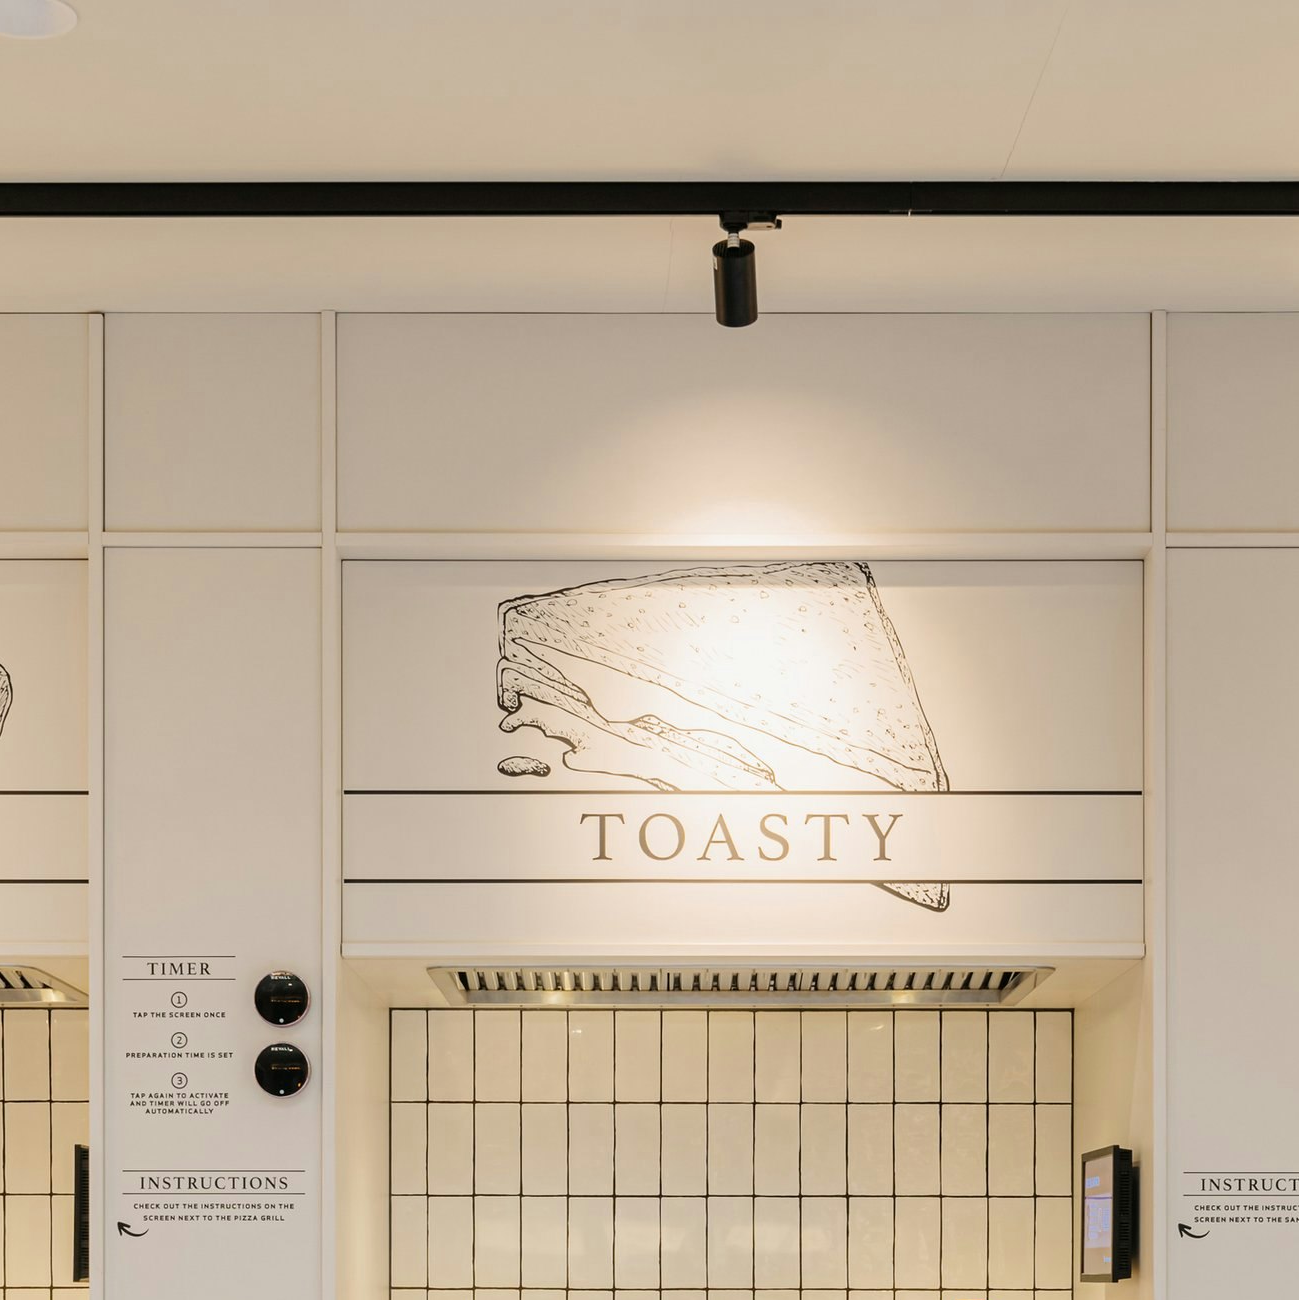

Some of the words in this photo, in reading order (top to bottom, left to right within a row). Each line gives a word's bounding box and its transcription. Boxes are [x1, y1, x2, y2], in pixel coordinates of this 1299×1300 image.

[580, 814, 903, 861] TOASTY
[147, 962, 211, 976] TIMER
[176, 995, 182, 1004] 1
[176, 1035, 182, 1044] 2
[176, 1076, 182, 1084] 3
[141, 1176, 288, 1190] INSTRUCTIONS
[143, 1214, 176, 1222] SCREEN
